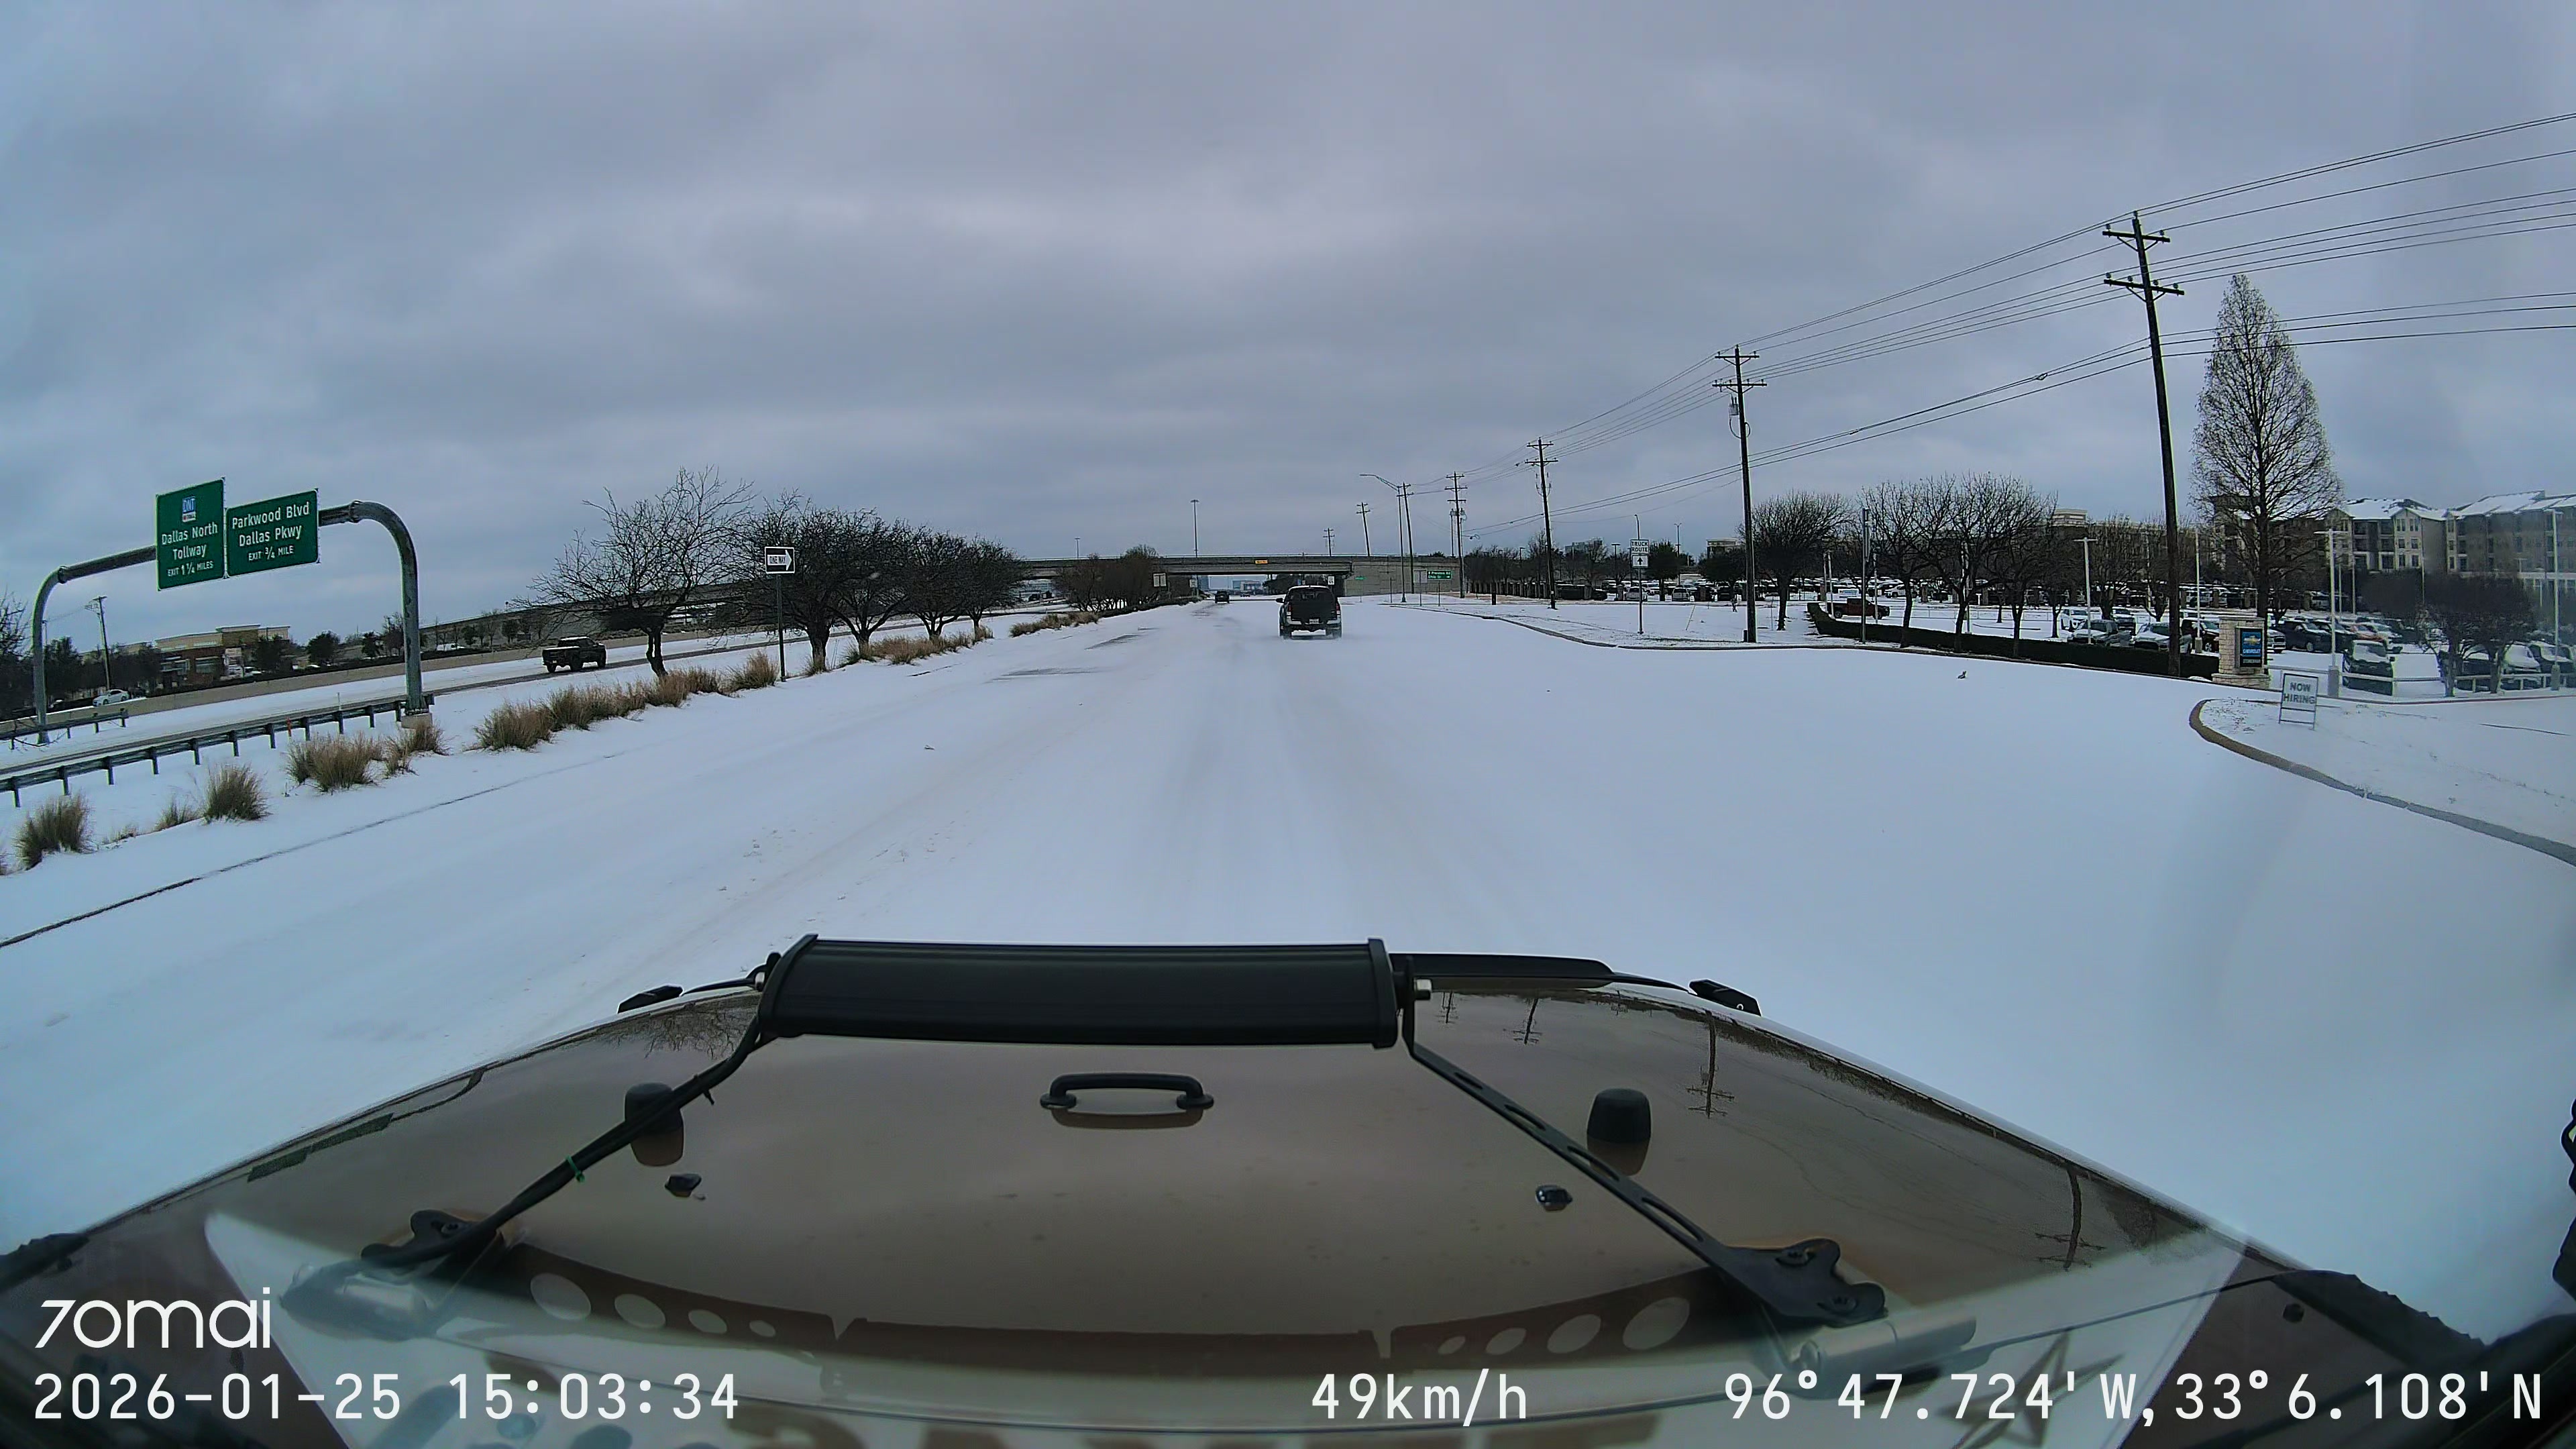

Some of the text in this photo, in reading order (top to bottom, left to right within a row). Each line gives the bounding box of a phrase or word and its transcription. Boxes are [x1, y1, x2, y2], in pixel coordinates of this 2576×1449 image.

[182, 498, 196, 513] DNT
[231, 501, 309, 529] Parkwood Blvd
[162, 521, 217, 545] Dallas North
[239, 525, 302, 547] Dallas Pkwy
[173, 544, 207, 560] Tollway
[249, 551, 262, 561] EXIT
[278, 545, 294, 556] MILE
[167, 568, 179, 577] EXIT
[197, 560, 214, 571] MILES
[2290, 682, 2311, 692] NOW
[2283, 693, 2316, 704] HIRING
